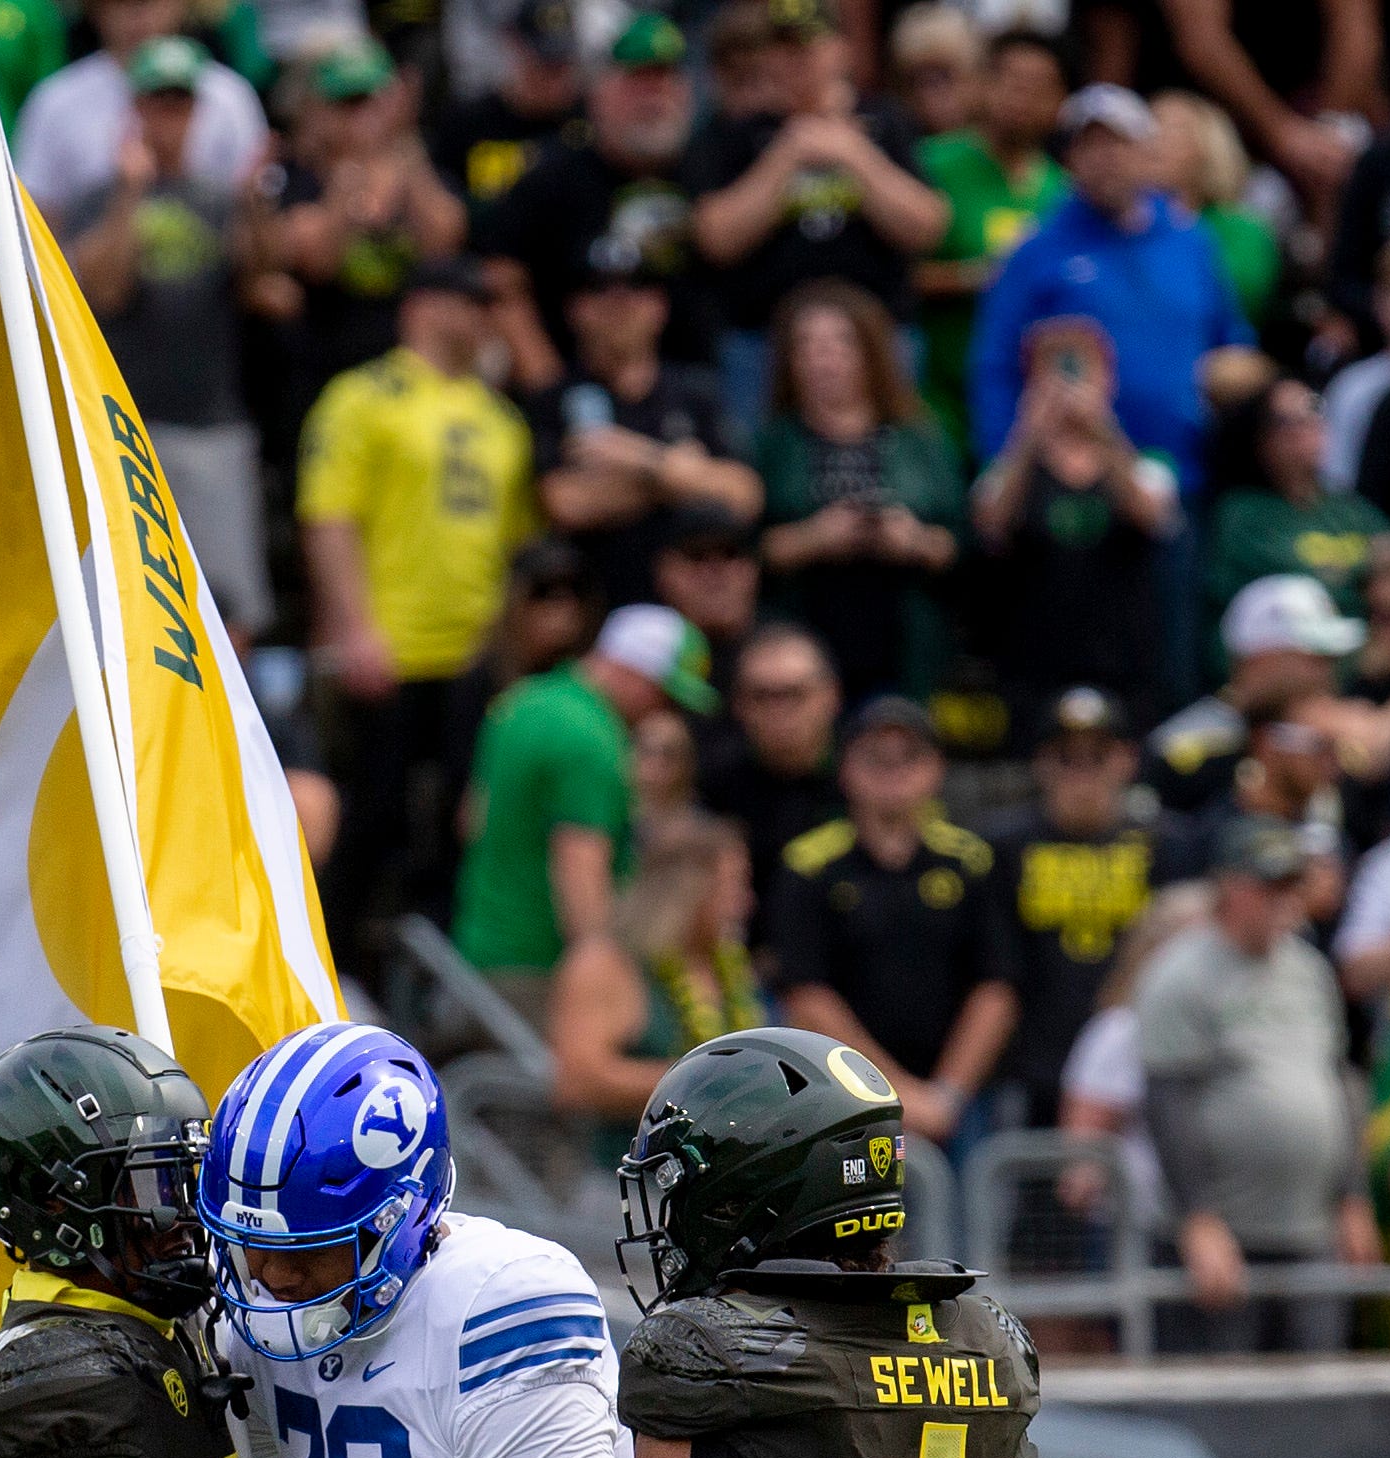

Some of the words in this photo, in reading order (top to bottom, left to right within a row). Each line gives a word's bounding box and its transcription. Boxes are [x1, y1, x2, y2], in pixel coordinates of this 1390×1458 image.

[102, 394, 204, 692] WEBB
[843, 1159, 866, 1176] END
[236, 1211, 263, 1228] BYU
[870, 1356, 1009, 1407] SEWELL
